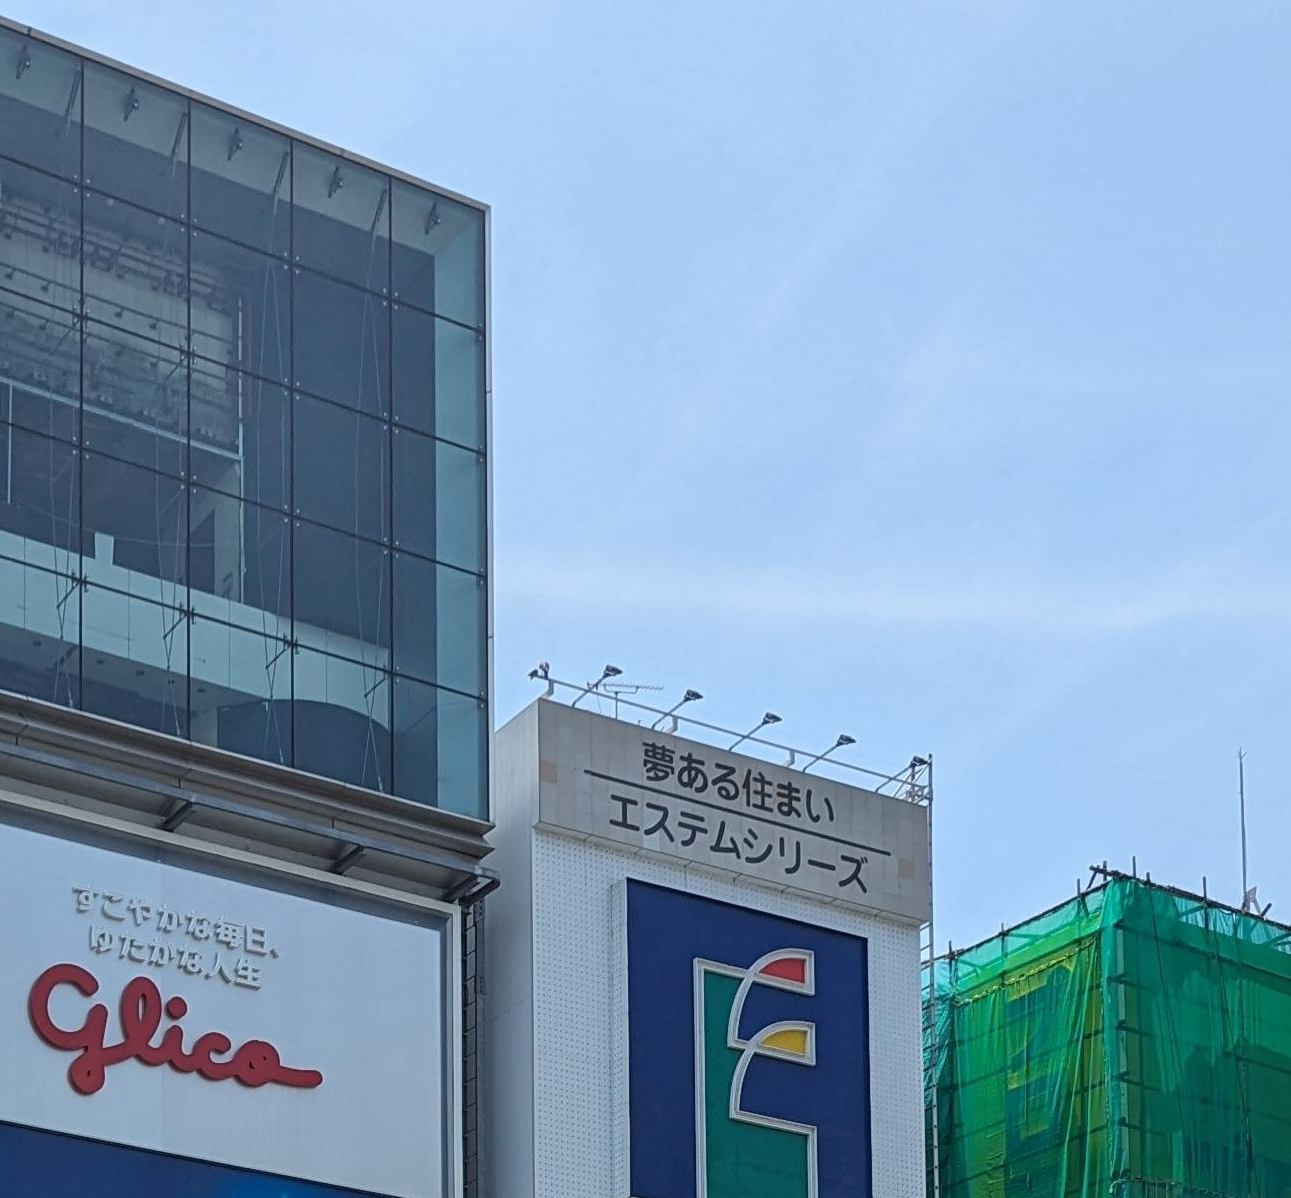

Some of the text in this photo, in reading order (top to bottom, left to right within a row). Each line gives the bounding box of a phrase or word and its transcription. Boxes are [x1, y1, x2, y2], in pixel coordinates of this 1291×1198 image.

[643, 741, 837, 825] 夢ある住まい
[608, 794, 870, 894] エステムシリーズ
[71, 884, 280, 958] すこやかな毎日、
[89, 924, 263, 990] ゆたかな人生
[28, 963, 324, 1095] Glico
